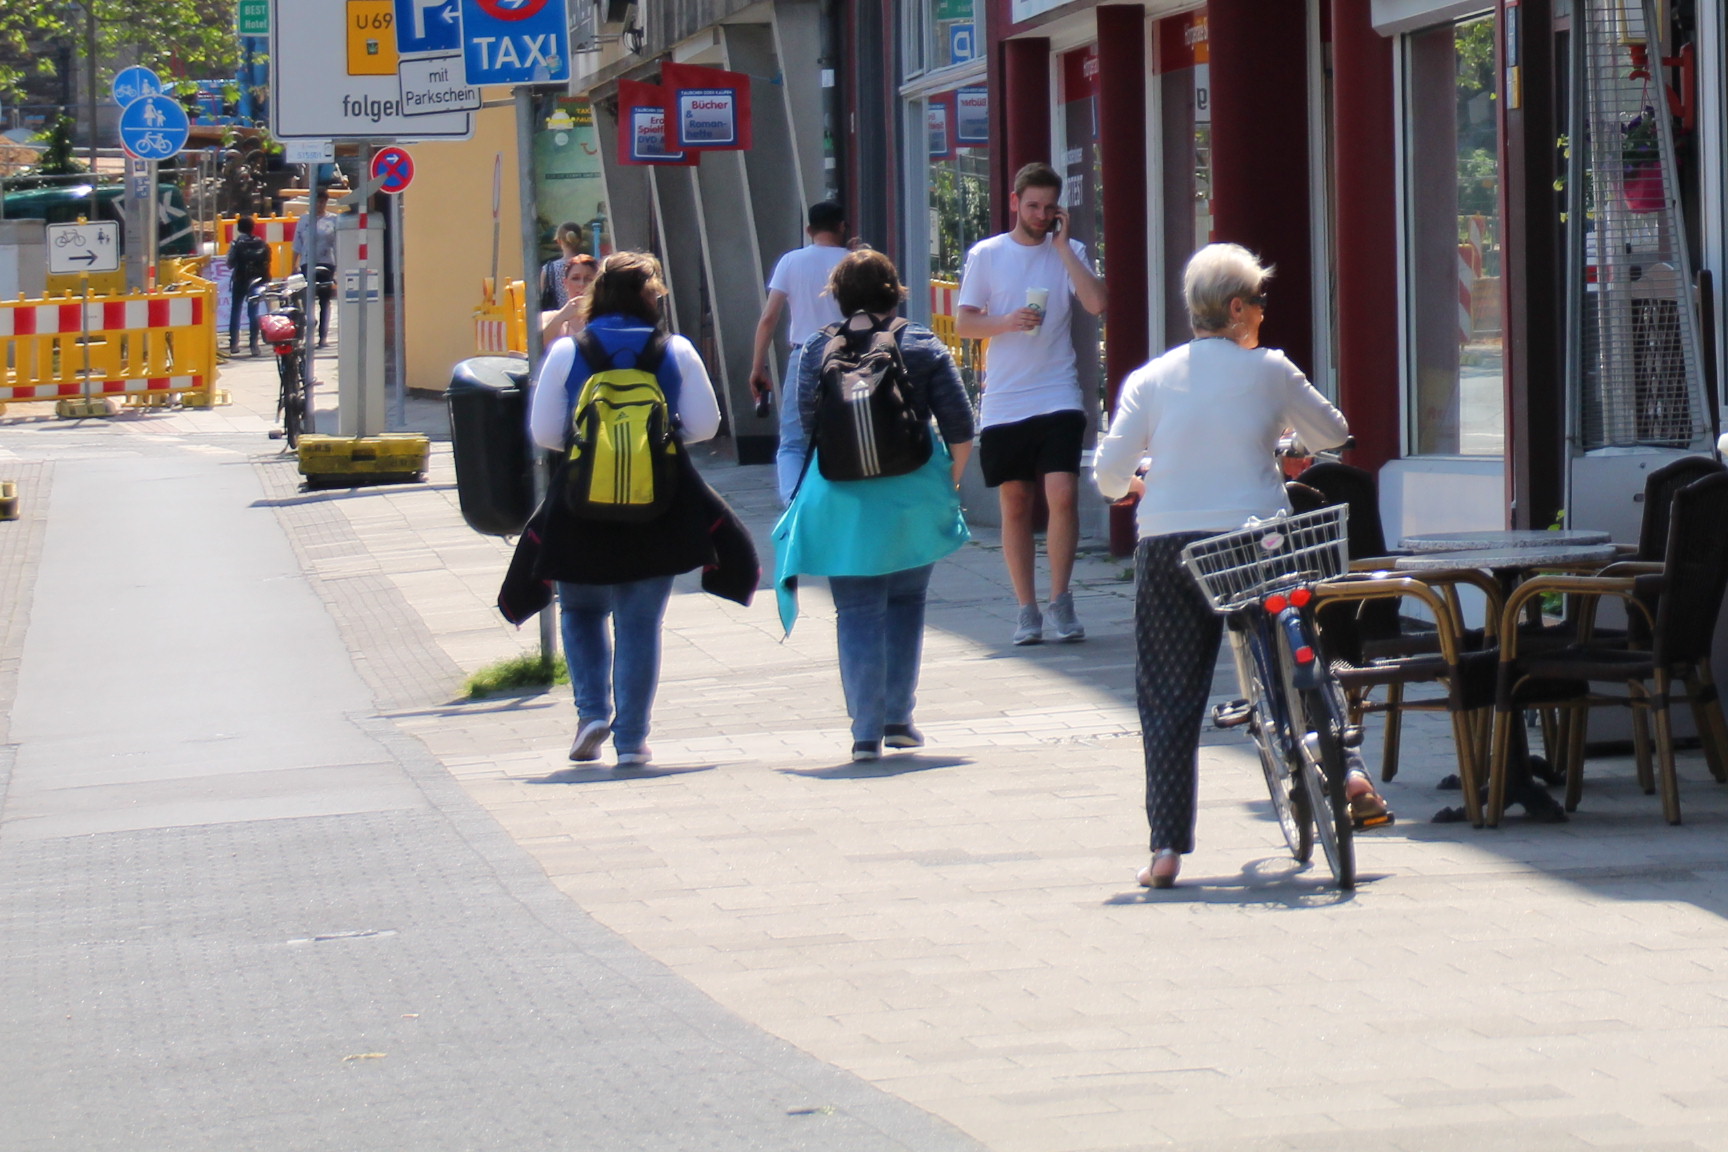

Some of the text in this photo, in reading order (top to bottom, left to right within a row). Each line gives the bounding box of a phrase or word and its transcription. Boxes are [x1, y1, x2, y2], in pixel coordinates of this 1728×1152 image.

[356, 13, 393, 30] U 69
[472, 33, 557, 71] TAXI
[429, 68, 449, 84] mit
[405, 85, 476, 106] Parkschein
[691, 100, 728, 110] Bücher
[685, 110, 693, 118] &
